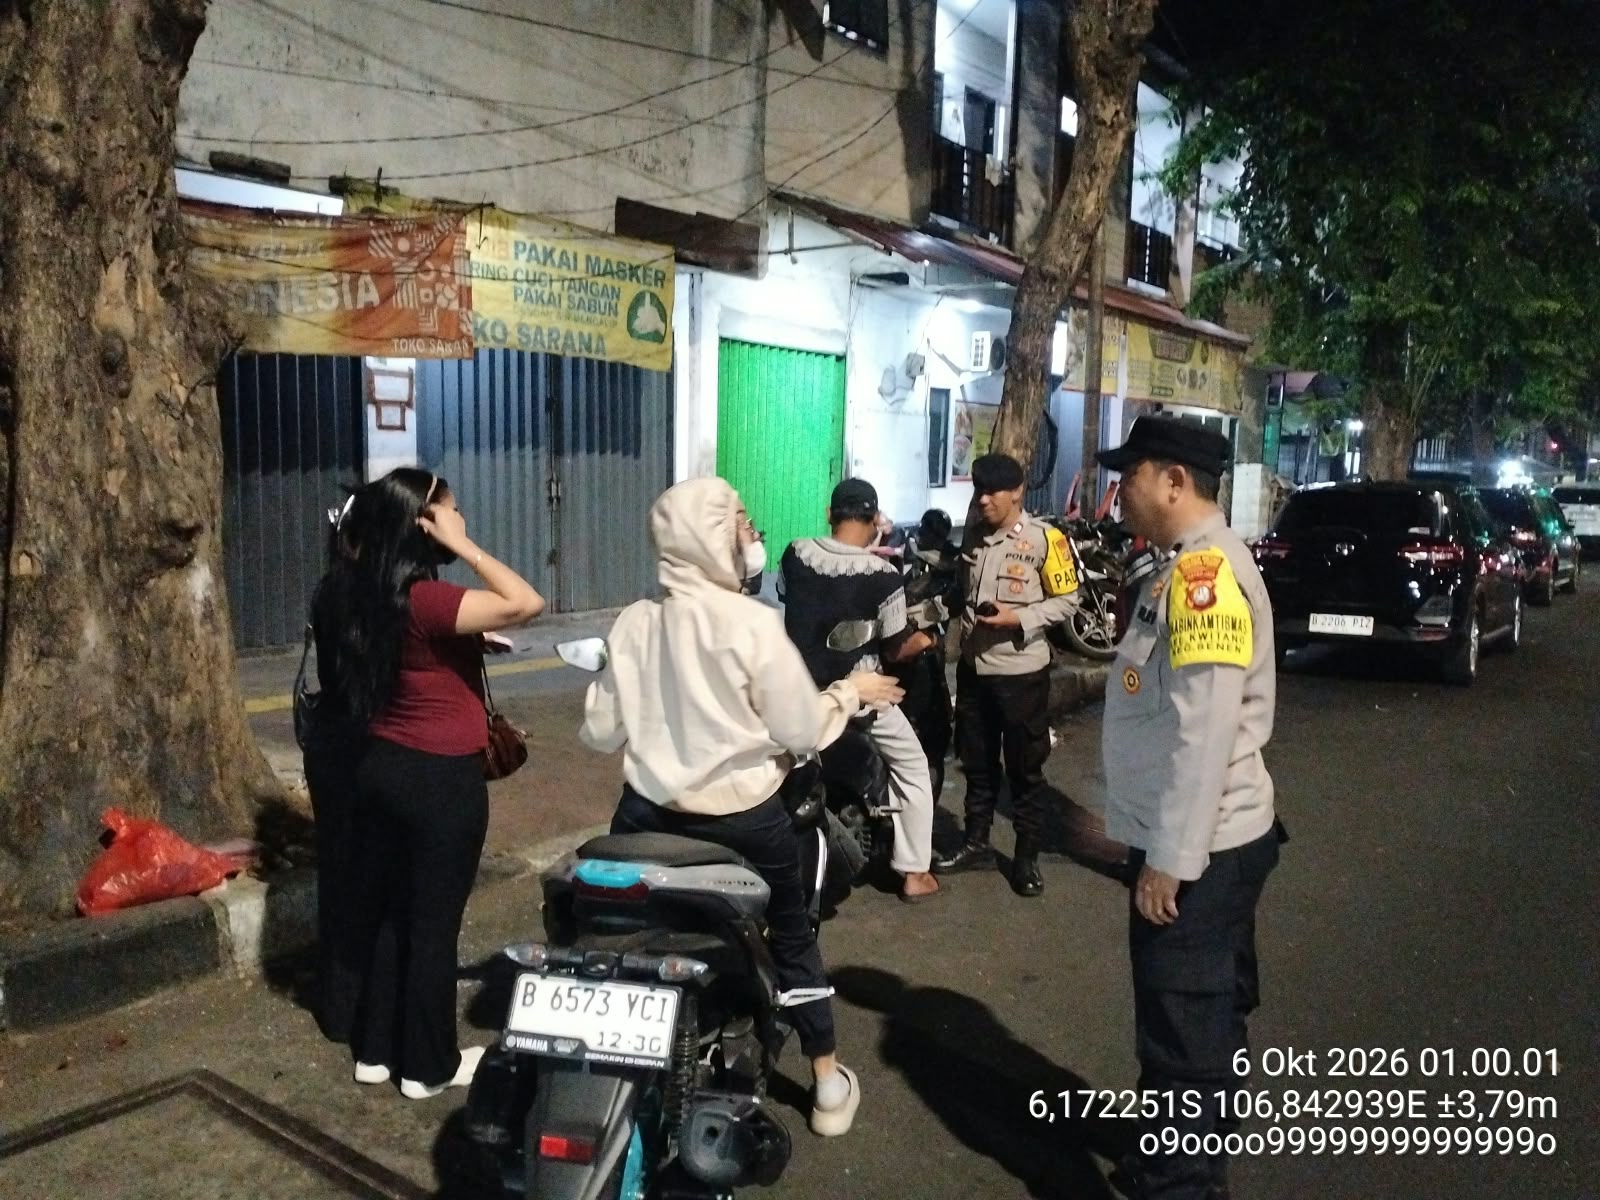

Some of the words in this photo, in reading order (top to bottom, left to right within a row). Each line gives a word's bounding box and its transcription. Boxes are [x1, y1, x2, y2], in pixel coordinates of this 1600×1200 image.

[471, 262, 507, 280] RING
[560, 278, 621, 300] TANGAN
[513, 240, 578, 271] PAKAI
[585, 254, 666, 288] MASKER
[513, 286, 561, 307] PAKAI
[568, 294, 618, 317] SABUN
[392, 338, 425, 353] TOKO
[473, 312, 508, 344] KO
[517, 322, 606, 356] SARANA
[1005, 552, 1035, 563] POLRI
[521, 981, 537, 1007] B
[550, 986, 612, 1016] 6573
[627, 992, 668, 1023] YCI
[516, 1036, 548, 1052] YAMAHA
